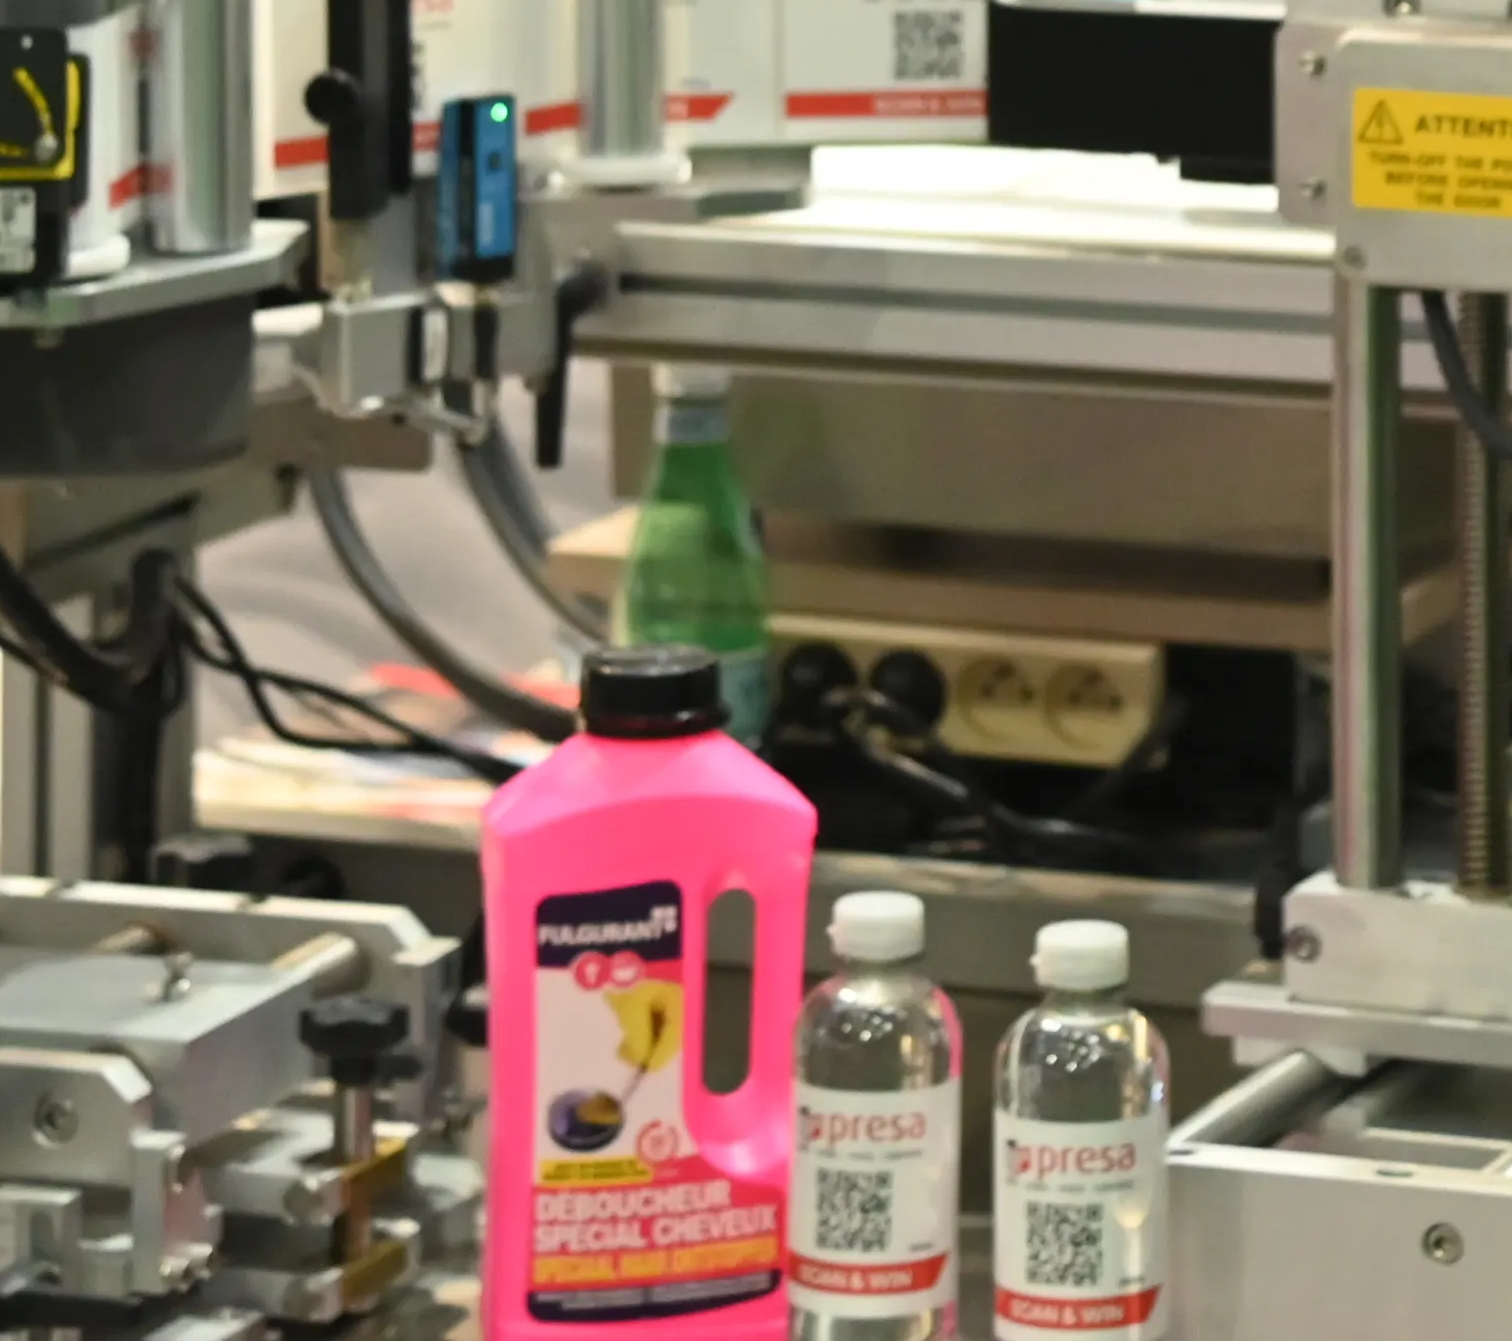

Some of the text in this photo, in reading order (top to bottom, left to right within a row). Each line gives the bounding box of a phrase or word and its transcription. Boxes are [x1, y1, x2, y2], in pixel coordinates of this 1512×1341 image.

[828, 1111, 926, 1146] presa
[1039, 1141, 1137, 1181] presa
[652, 1203, 779, 1247] CHEVEUX
